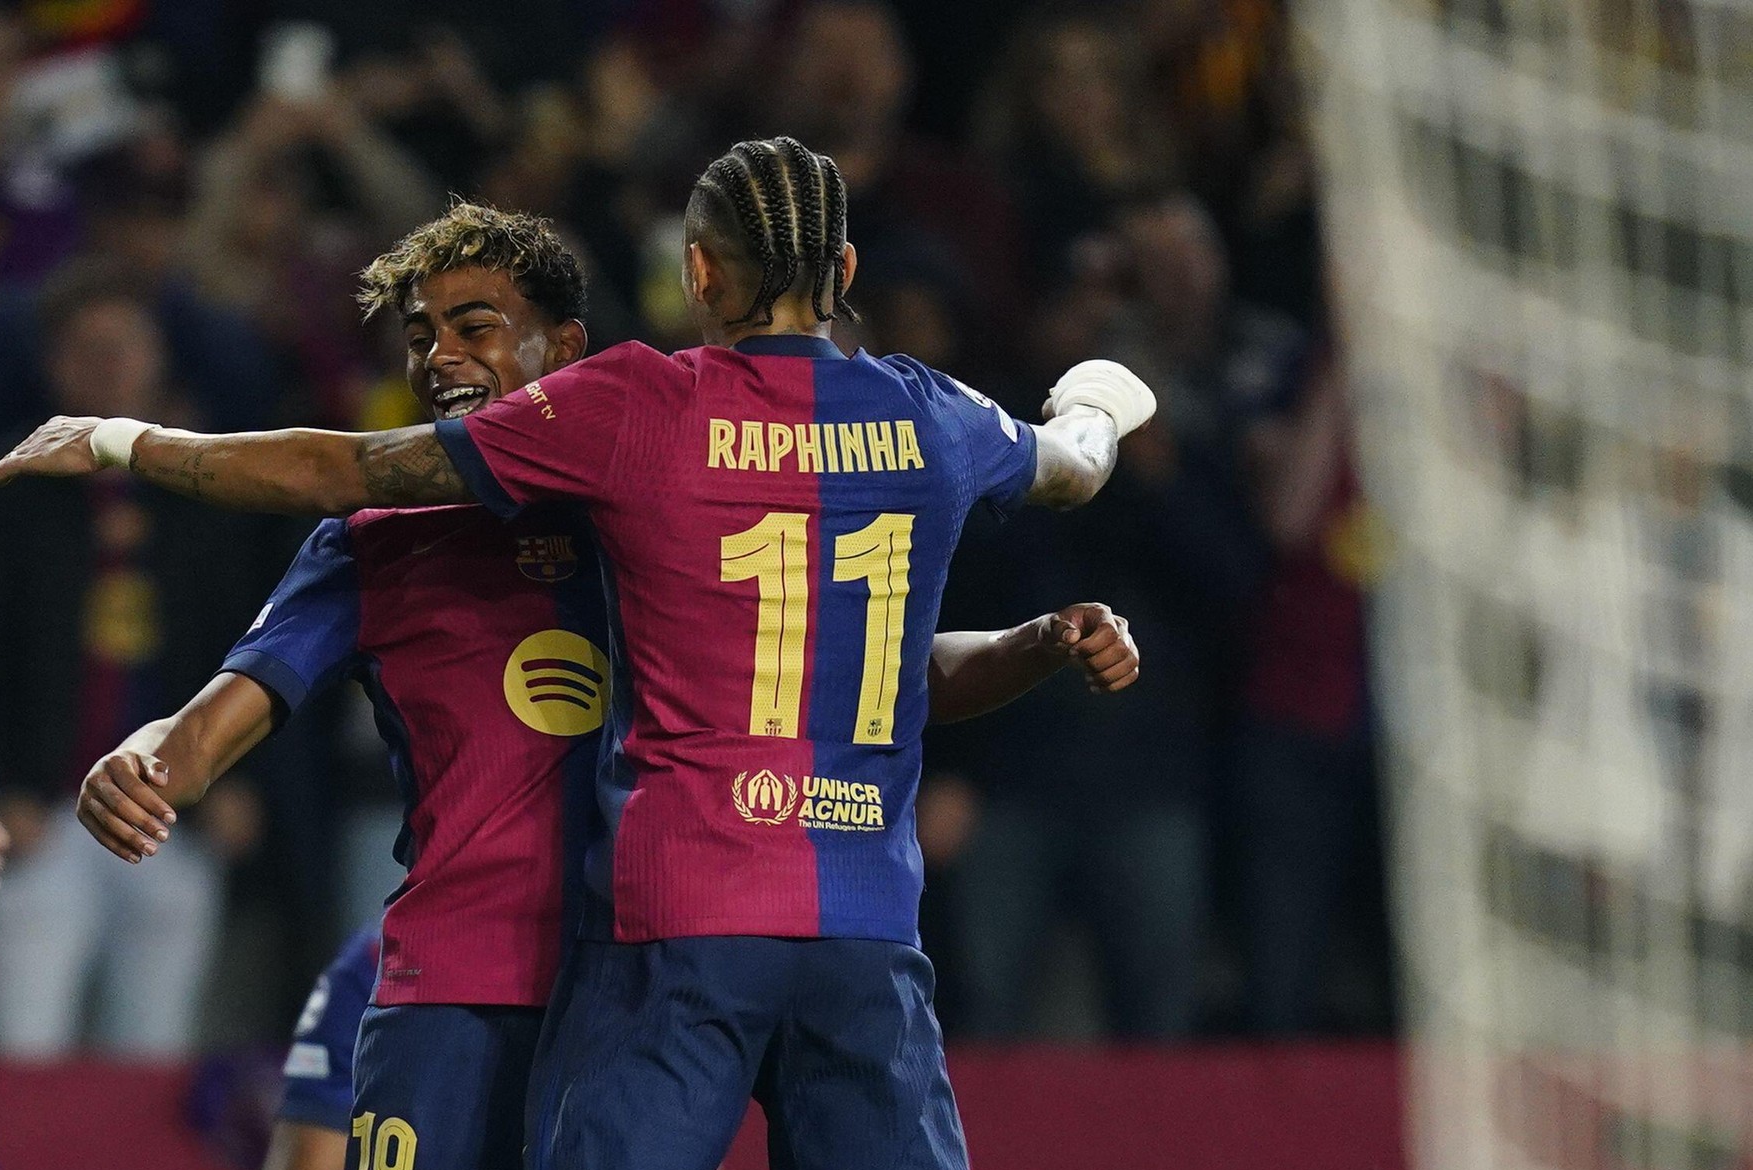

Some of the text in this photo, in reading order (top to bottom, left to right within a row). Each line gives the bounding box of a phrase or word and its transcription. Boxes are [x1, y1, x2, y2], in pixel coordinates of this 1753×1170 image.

[541, 404, 556, 420] tv
[707, 418, 925, 473] RAPHINHA
[720, 512, 917, 745] 11
[802, 775, 883, 805] UNHCR
[797, 798, 884, 826] ACNUR
[798, 818, 812, 829] The
[812, 819, 825, 830] UN
